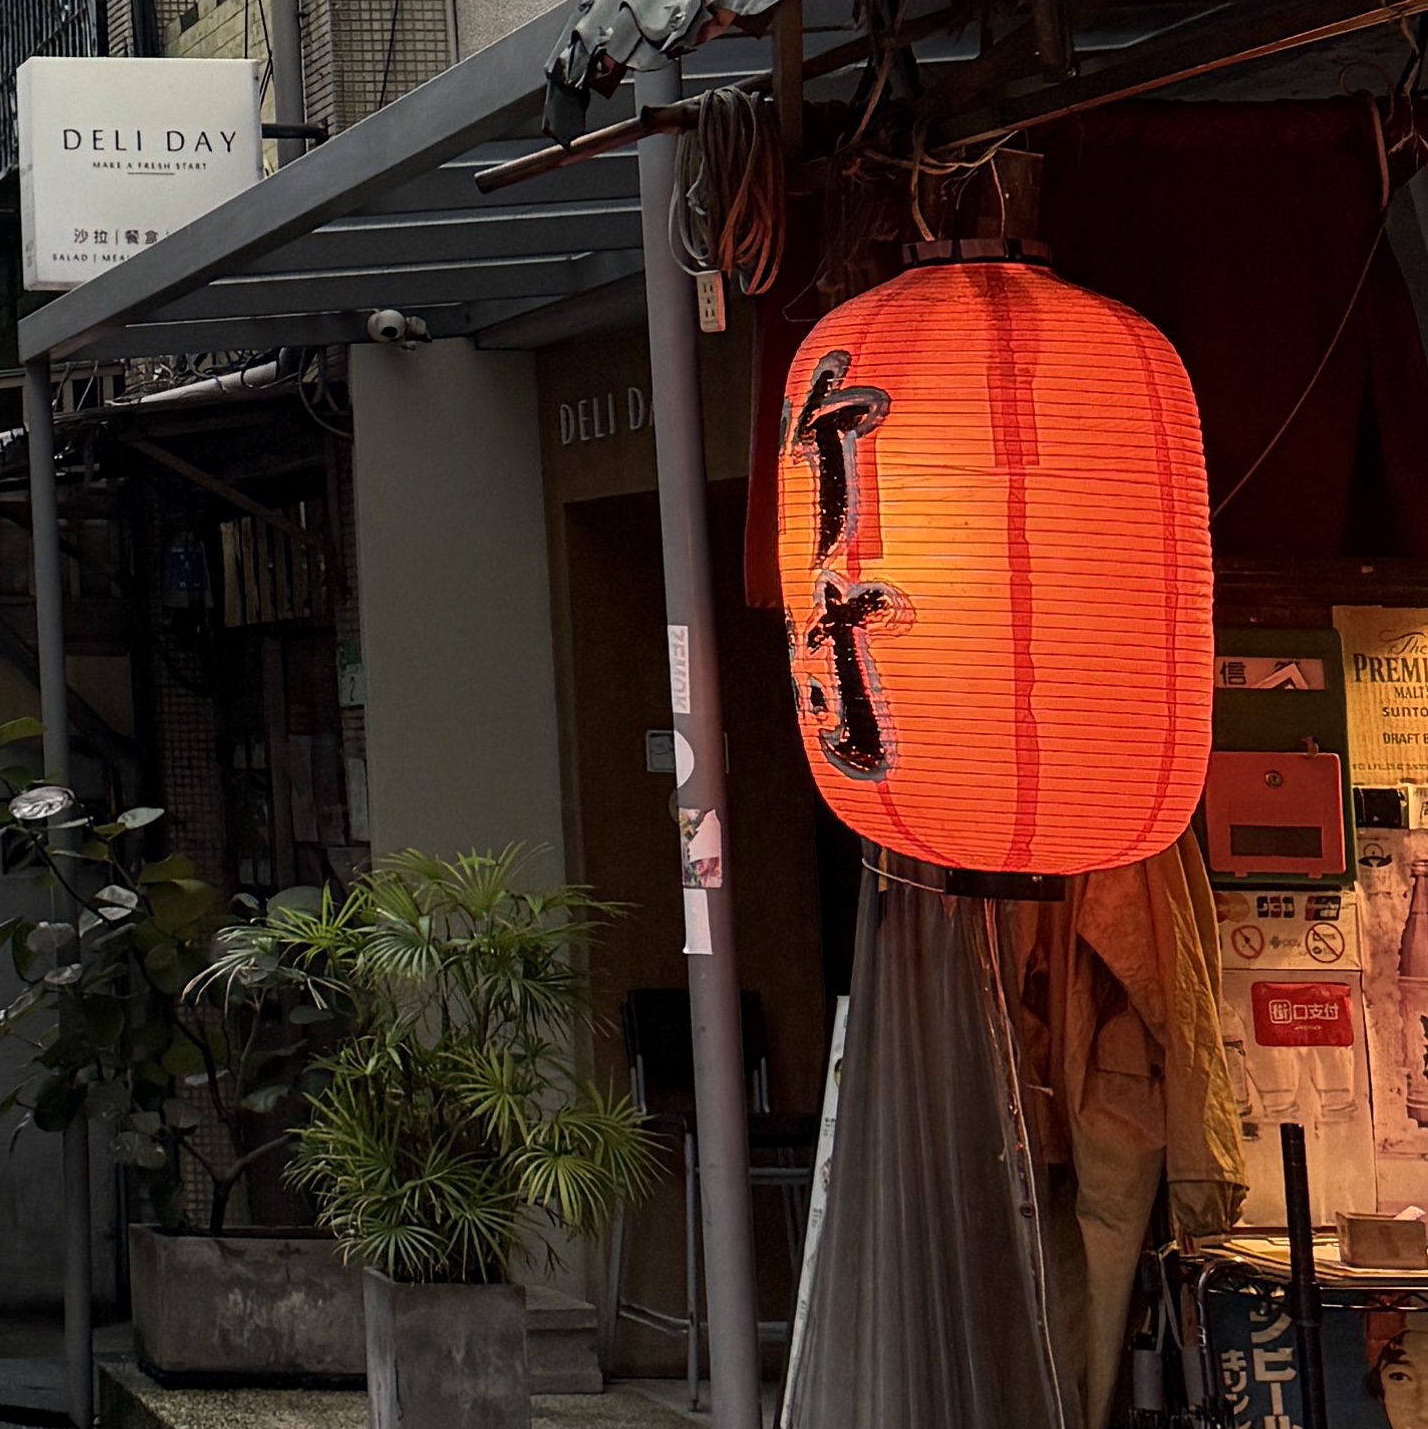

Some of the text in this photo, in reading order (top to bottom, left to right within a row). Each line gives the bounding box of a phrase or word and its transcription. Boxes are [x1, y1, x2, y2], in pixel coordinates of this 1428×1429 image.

[63, 128, 236, 153] DELI DAY
[92, 161, 207, 171] MAKE A FRESH START
[74, 228, 159, 245] 沙拉 餐盒
[53, 254, 131, 262] SALAD MEA
[559, 387, 654, 445] DELI D
[1383, 733, 1419, 745] DRAFT
[1269, 999, 1339, 1024] 街口支付
